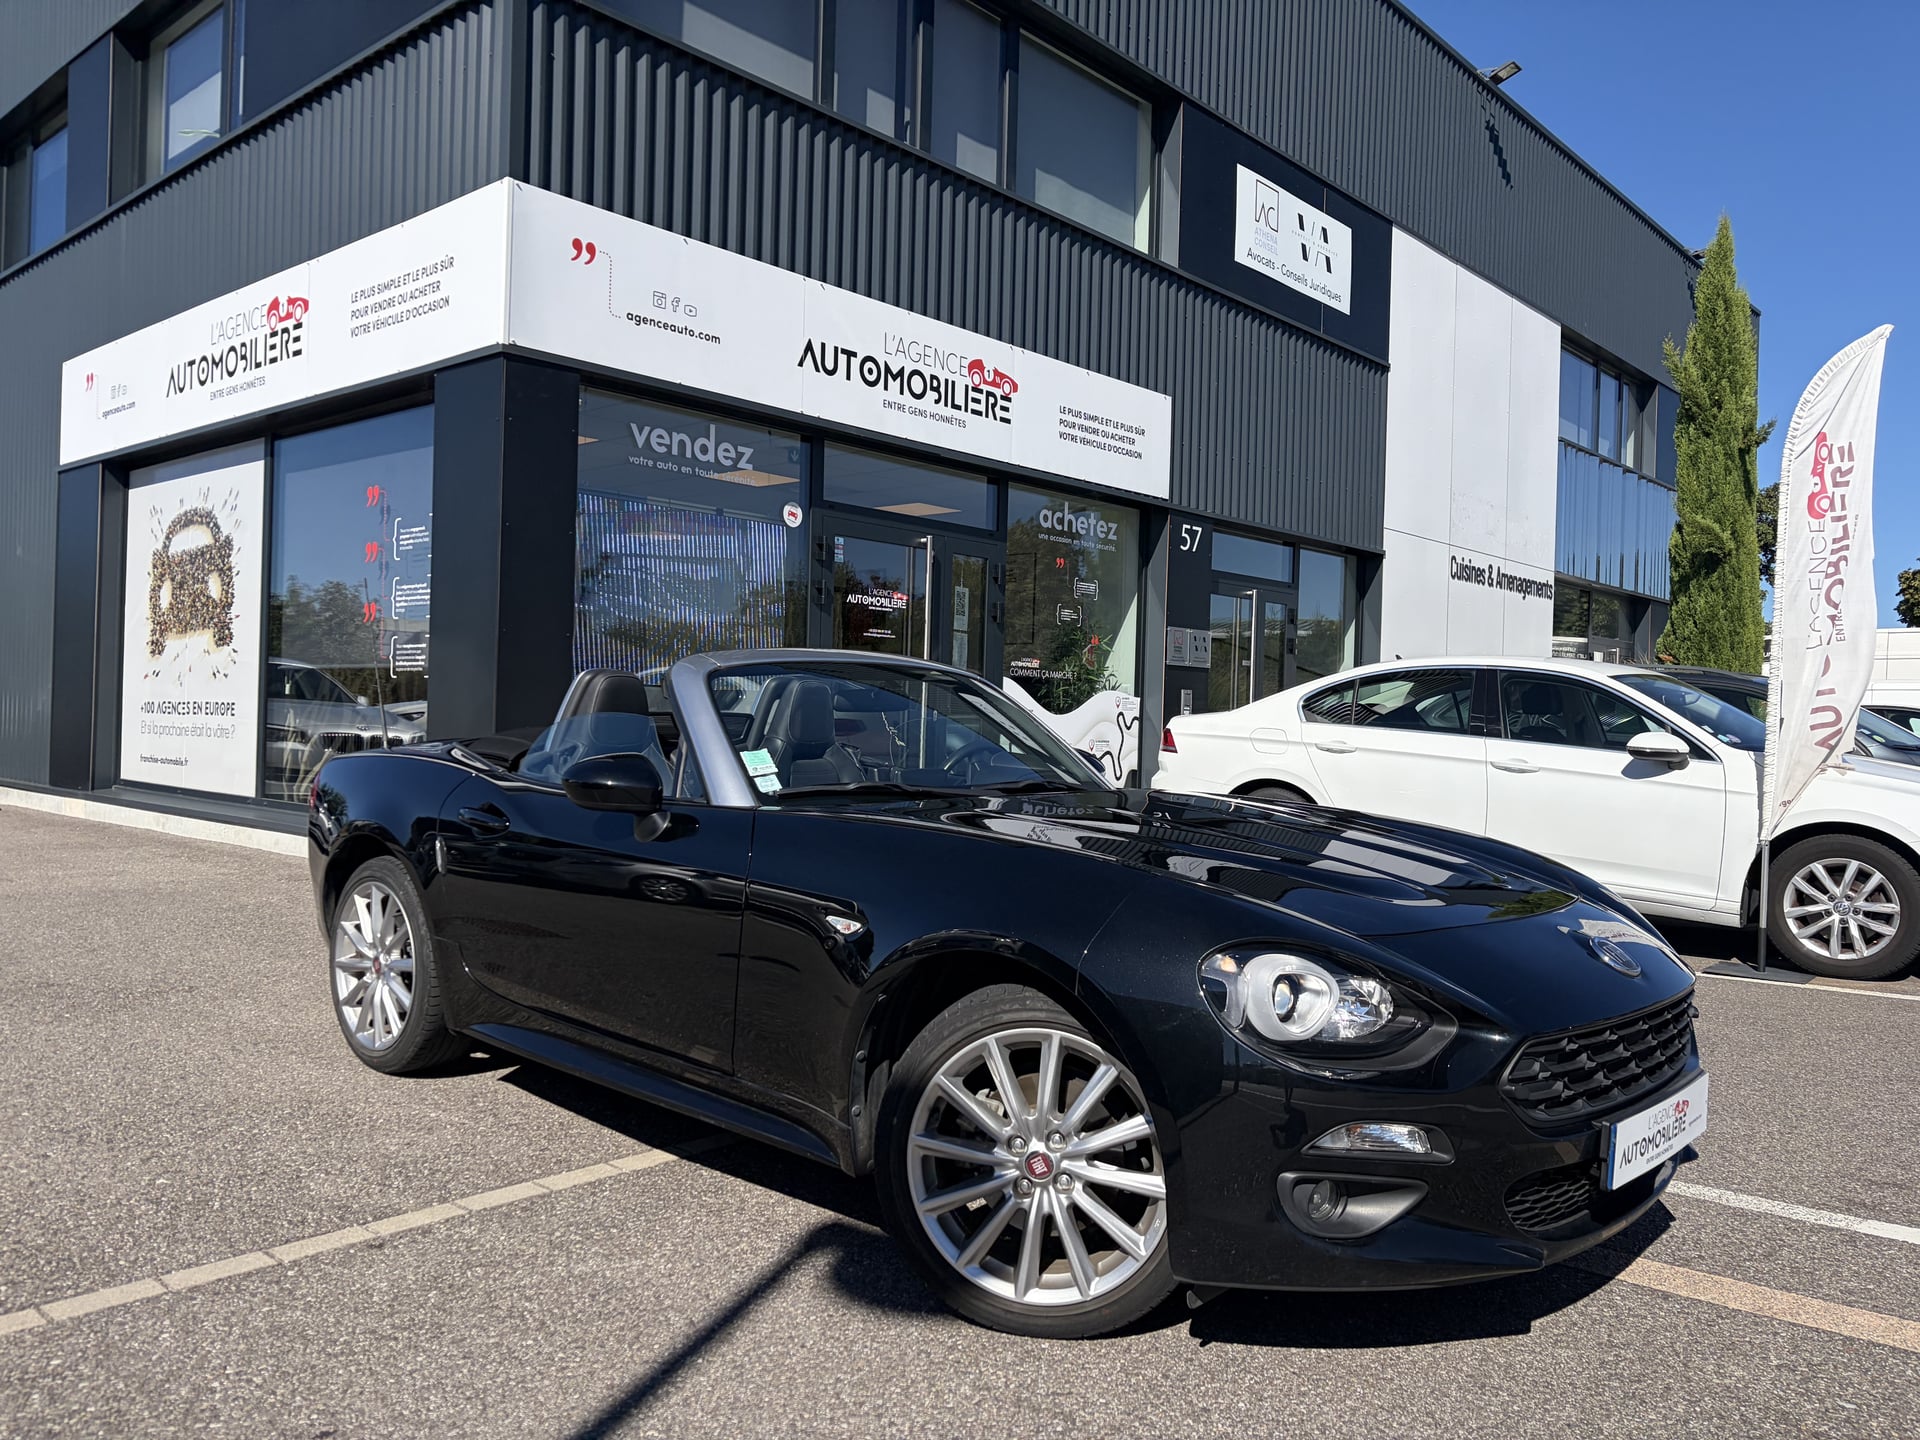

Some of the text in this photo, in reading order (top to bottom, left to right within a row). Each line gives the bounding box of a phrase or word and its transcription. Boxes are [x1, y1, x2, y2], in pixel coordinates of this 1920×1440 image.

[351, 254, 455, 304] LE PLUS SIMPLE ET LE PLUS SÛR
[1247, 247, 1276, 270] Avocats
[1280, 263, 1309, 287] Conseils
[1309, 278, 1342, 303] Juridiques
[350, 280, 441, 320] POUR VENDRE OU ACHETER
[210, 303, 268, 346] L'AGENCE
[350, 295, 450, 338] VOTRE VÉHICULE D'OCCASION
[626, 312, 721, 345] agenceauto.com
[884, 332, 968, 378] L'AGENCE
[210, 376, 266, 400] ENTRE GENS HONNÊTES
[883, 399, 967, 429] ENTRE GENS HONNÊTES
[1059, 405, 1067, 415] LE
[1067, 407, 1083, 420] PLUS
[1083, 412, 1105, 426] SIMPLE
[1105, 418, 1112, 428] ET
[1112, 420, 1120, 430] LE
[1120, 422, 1134, 434] PLUS
[630, 422, 754, 471] vendez
[1058, 430, 1143, 460] VOTRE VÉHICULE D'OCCASION
[1059, 418, 1136, 446] POUR VENDRE OU ACHETER
[628, 455, 654, 467] votre
[656, 461, 678, 472] auto
[681, 466, 692, 475] en
[694, 467, 719, 480] toute
[1039, 501, 1118, 540] achetez
[1049, 535, 1072, 545] occasion
[1081, 540, 1095, 549] toute
[1180, 523, 1203, 552] 57
[869, 588, 894, 598] L'AGENCE
[1450, 555, 1553, 601] Cuisines & Amenagements
[1009, 668, 1040, 678] COMMENT
[1050, 671, 1073, 680] MARCHE
[140, 700, 236, 717] +100 AGENCES EN EUROPE
[159, 721, 190, 739] prochaine
[205, 722, 212, 738] la
[1030, 1156, 1048, 1175] FIAT
